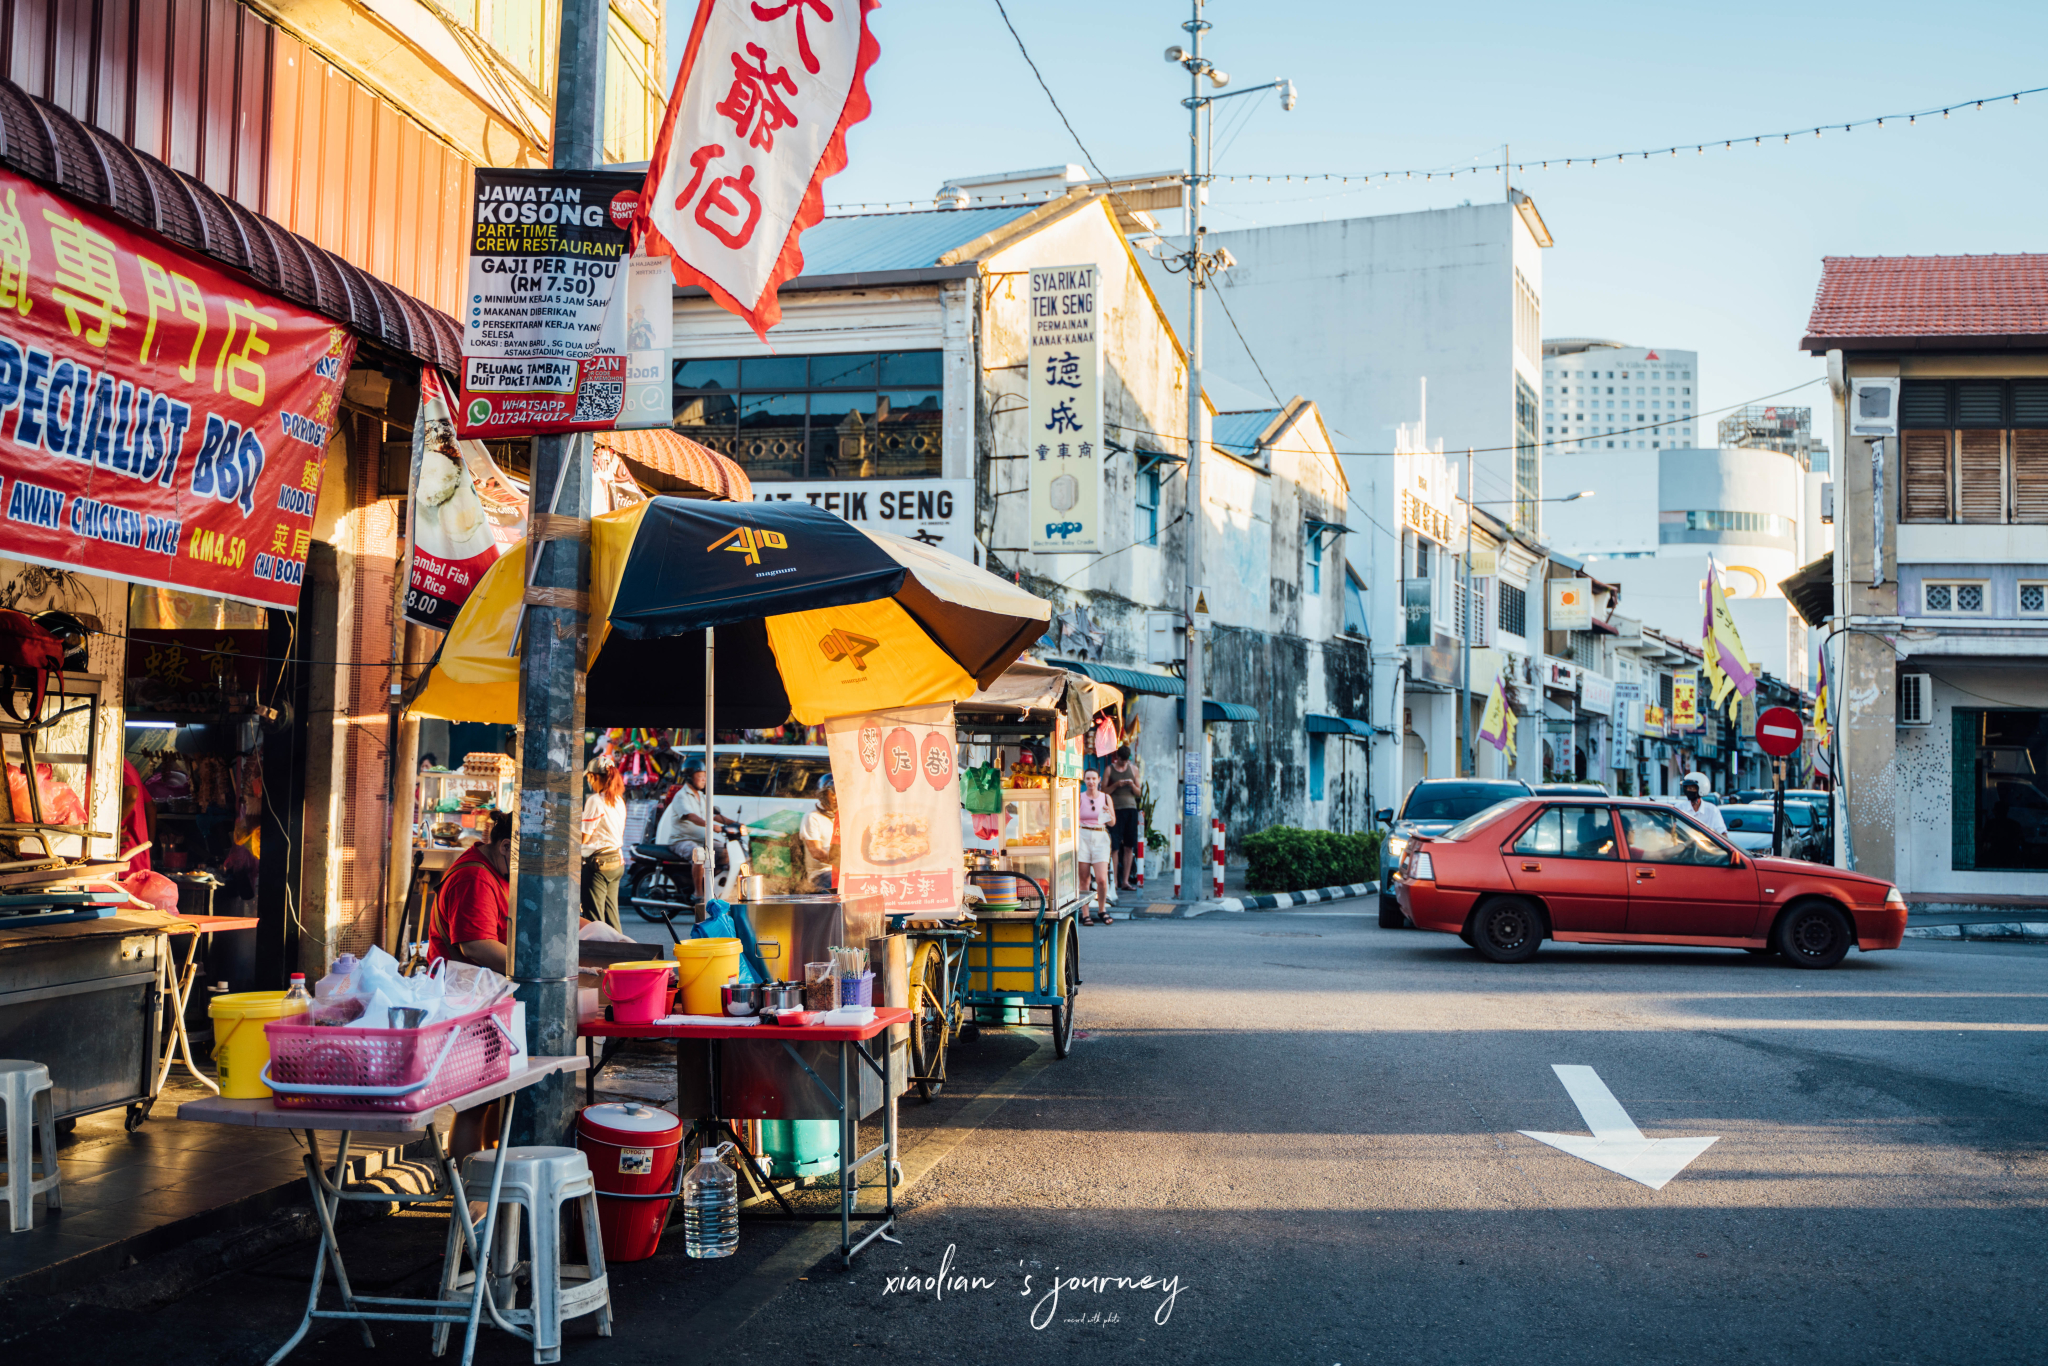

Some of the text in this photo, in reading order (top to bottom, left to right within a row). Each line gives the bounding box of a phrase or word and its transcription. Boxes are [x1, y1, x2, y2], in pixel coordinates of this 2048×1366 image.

[478, 185, 581, 203] JAWATAN
[477, 202, 604, 228] KOSONG
[612, 209, 637, 219] TOMY
[477, 223, 557, 237] PART-TIME
[475, 237, 521, 251] CREW
[524, 239, 624, 257] RESTAURANT
[481, 258, 527, 274] GAJI
[533, 258, 567, 274] PER
[510, 274, 596, 297] (RM 7.50)
[1033, 269, 1093, 292] SYARIKAT
[484, 295, 527, 304] MINIMUM
[528, 295, 554, 304] KERJA
[555, 295, 561, 304] 5
[563, 296, 584, 306] JAM
[1032, 293, 1093, 317] TEIK SENG
[484, 308, 577, 318] MAKANAN DIBERIKAN
[482, 320, 543, 329] PERSEKITARAN
[544, 320, 575, 331] KERJA
[1037, 318, 1088, 332] PERMAINAN
[481, 330, 514, 339] SELESA
[1032, 332, 1095, 347] KANAK-KANAK
[470, 339, 499, 347] LOKASI
[504, 340, 528, 348] BAYAN
[529, 339, 546, 348] BARU
[552, 340, 563, 348] SG
[564, 341, 583, 350] DUA
[504, 348, 531, 356] ASTAKA
[531, 348, 564, 357] STADIUM
[475, 361, 523, 375] PELUANG
[526, 363, 570, 376] TAMBAH
[498, 374, 531, 387] POKET
[531, 374, 561, 387] ANDA
[1045, 351, 1083, 434] 德成
[502, 399, 565, 412] WHATSAPP
[490, 412, 571, 425] 0173474017
[1035, 441, 1094, 461] 童車商
[190, 412, 265, 520] BBQ
[879, 490, 953, 520] SENG
[7, 480, 246, 569] AWAY CHICKEN RICE RM4.50
[254, 552, 275, 580] CHAI
[755, 567, 797, 578] magnum
[448, 566, 470, 587] Fish
[424, 576, 446, 596] Rice
